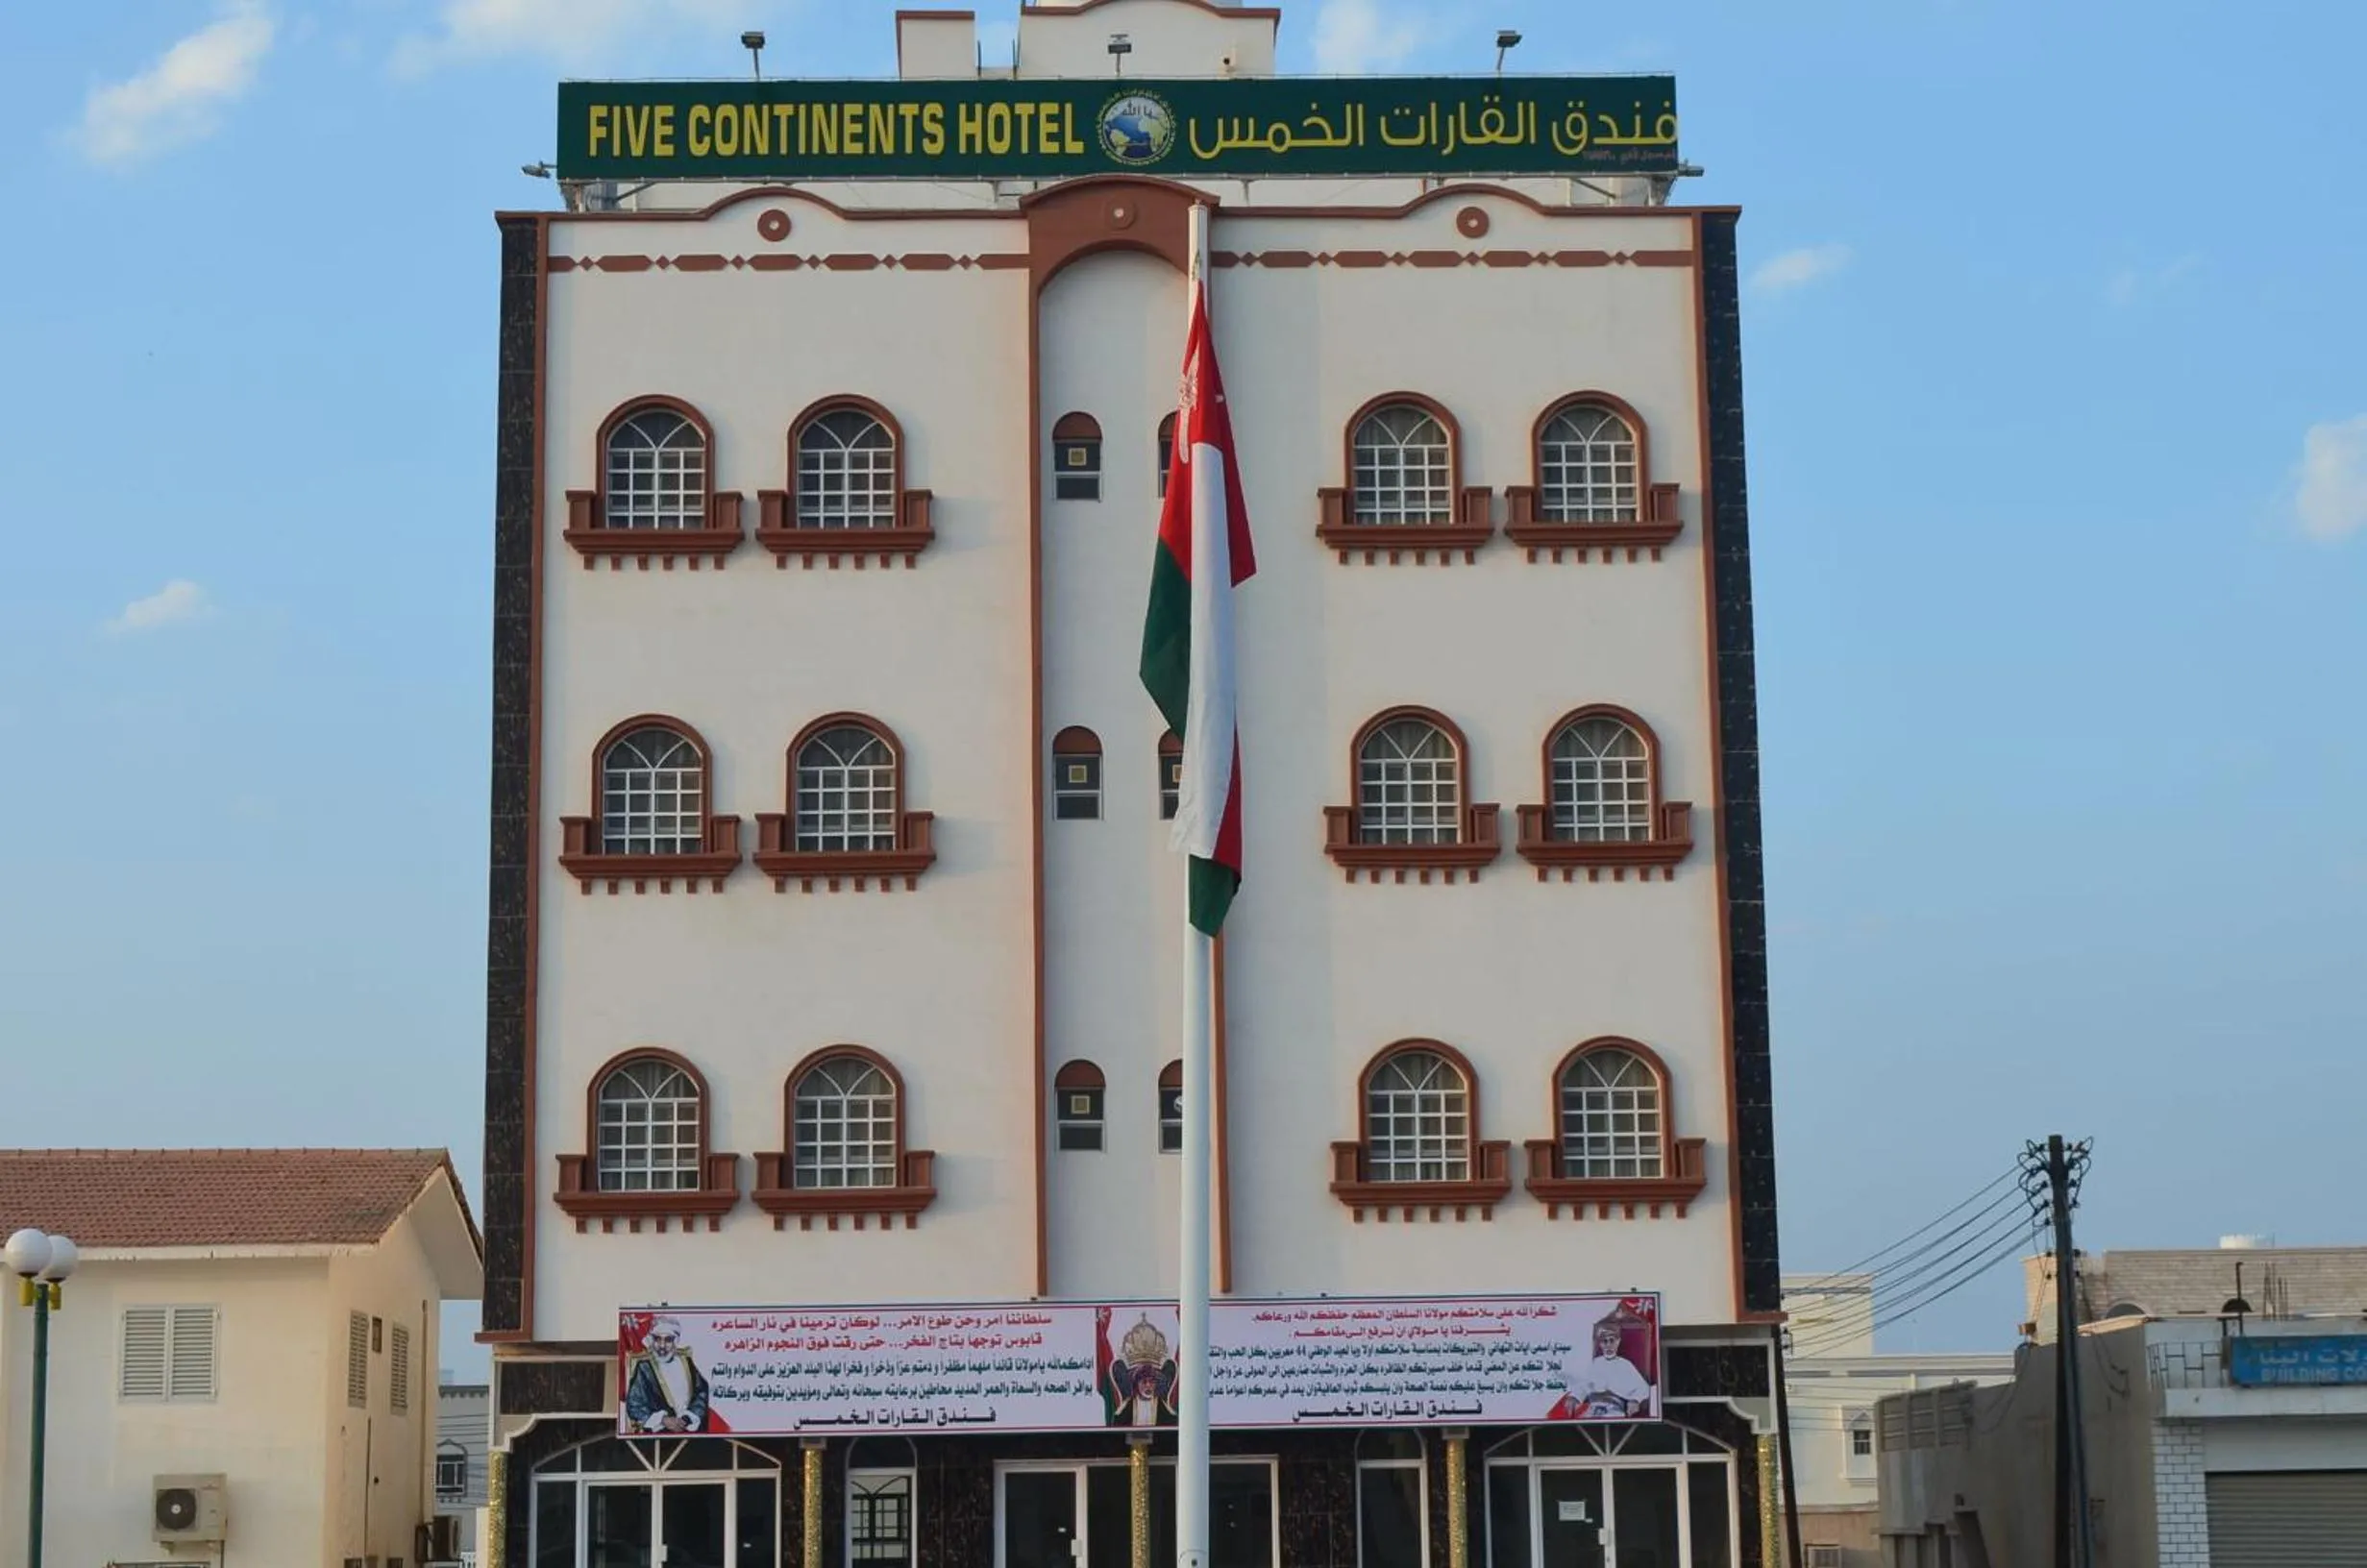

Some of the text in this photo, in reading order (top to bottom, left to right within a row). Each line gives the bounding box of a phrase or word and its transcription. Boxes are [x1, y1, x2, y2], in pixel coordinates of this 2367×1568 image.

[588, 104, 674, 158] FIVE
[688, 102, 946, 157] CONTINENTS
[959, 101, 1085, 156] HOTEL
[1188, 102, 1365, 160] الخمس
[1378, 95, 1537, 157] القارات
[1551, 100, 1678, 156] فندق
[876, 1408, 933, 1427] القارات
[1370, 1401, 1424, 1418] القارات
